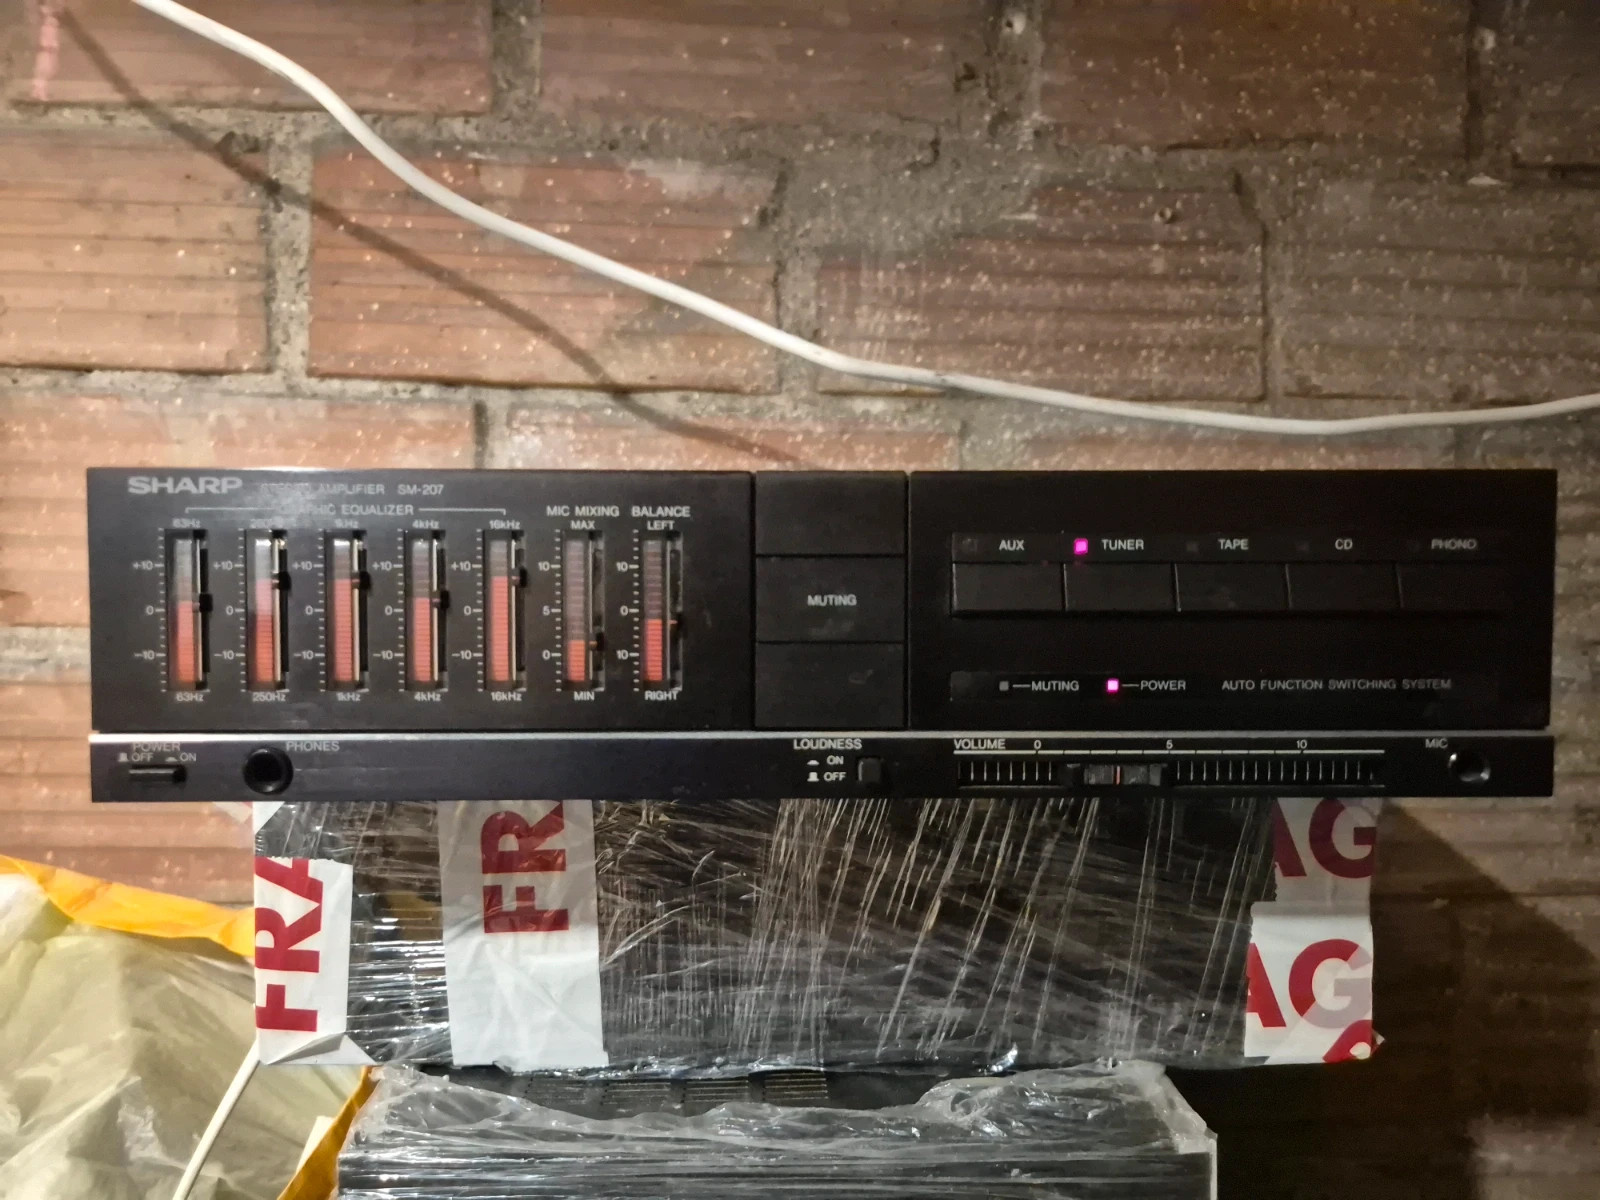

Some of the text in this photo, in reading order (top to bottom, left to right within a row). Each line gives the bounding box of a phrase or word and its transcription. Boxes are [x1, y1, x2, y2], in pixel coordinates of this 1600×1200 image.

[127, 476, 243, 494] SHARP
[319, 484, 385, 495] AMPLIFIER
[398, 484, 444, 495] SM-207
[341, 504, 414, 515] EQUALIZER
[547, 506, 620, 517] MIC MIXING
[631, 506, 690, 517] BALANCE
[412, 519, 440, 529] 4kHz
[489, 520, 521, 530] 16kHz
[571, 520, 595, 530] MAX
[647, 520, 675, 530] LEFT
[999, 539, 1025, 551] AUX
[1101, 539, 1144, 550] TUNER
[1218, 539, 1249, 550] TAPE
[1335, 539, 1353, 550] CD
[1431, 538, 1478, 550] PHONO
[132, 561, 153, 571] +10
[213, 561, 233, 571] +10
[292, 561, 312, 571] +10
[372, 561, 392, 571] +10
[451, 561, 471, 571] +10
[538, 561, 550, 571] 10
[616, 561, 628, 572] 10
[807, 594, 857, 606] MUTING
[145, 605, 154, 616] 0
[225, 605, 234, 616] 0
[305, 605, 313, 616] 0
[384, 605, 393, 616] 0
[463, 605, 472, 616] 0
[542, 605, 550, 616] 5
[620, 605, 629, 616] 0
[542, 649, 550, 660] 0
[617, 649, 629, 660] 10
[1031, 681, 1079, 692] MUTING
[1140, 680, 1186, 691] POWER
[1221, 679, 1452, 691] AUTO FUNCTION SWITCHING SYSTEM
[176, 693, 204, 702] 63Hz
[252, 692, 286, 702] 250Hz
[336, 692, 361, 702] 1kHz
[414, 692, 441, 702] 4kHz
[491, 691, 522, 702] 16kHz
[574, 691, 595, 702] MIN
[644, 691, 678, 702] RIGHT
[132, 742, 181, 752] POWER
[286, 741, 340, 752] PHONES
[793, 738, 862, 750] LOUDNESS
[953, 739, 1006, 750] VOLUME
[1033, 740, 1042, 750] 0
[1166, 739, 1174, 750] 5
[1296, 739, 1308, 750] 10
[1425, 738, 1448, 749] MIC
[131, 753, 197, 762] OFF ON
[826, 755, 844, 766] ON
[823, 772, 847, 781] OFF
